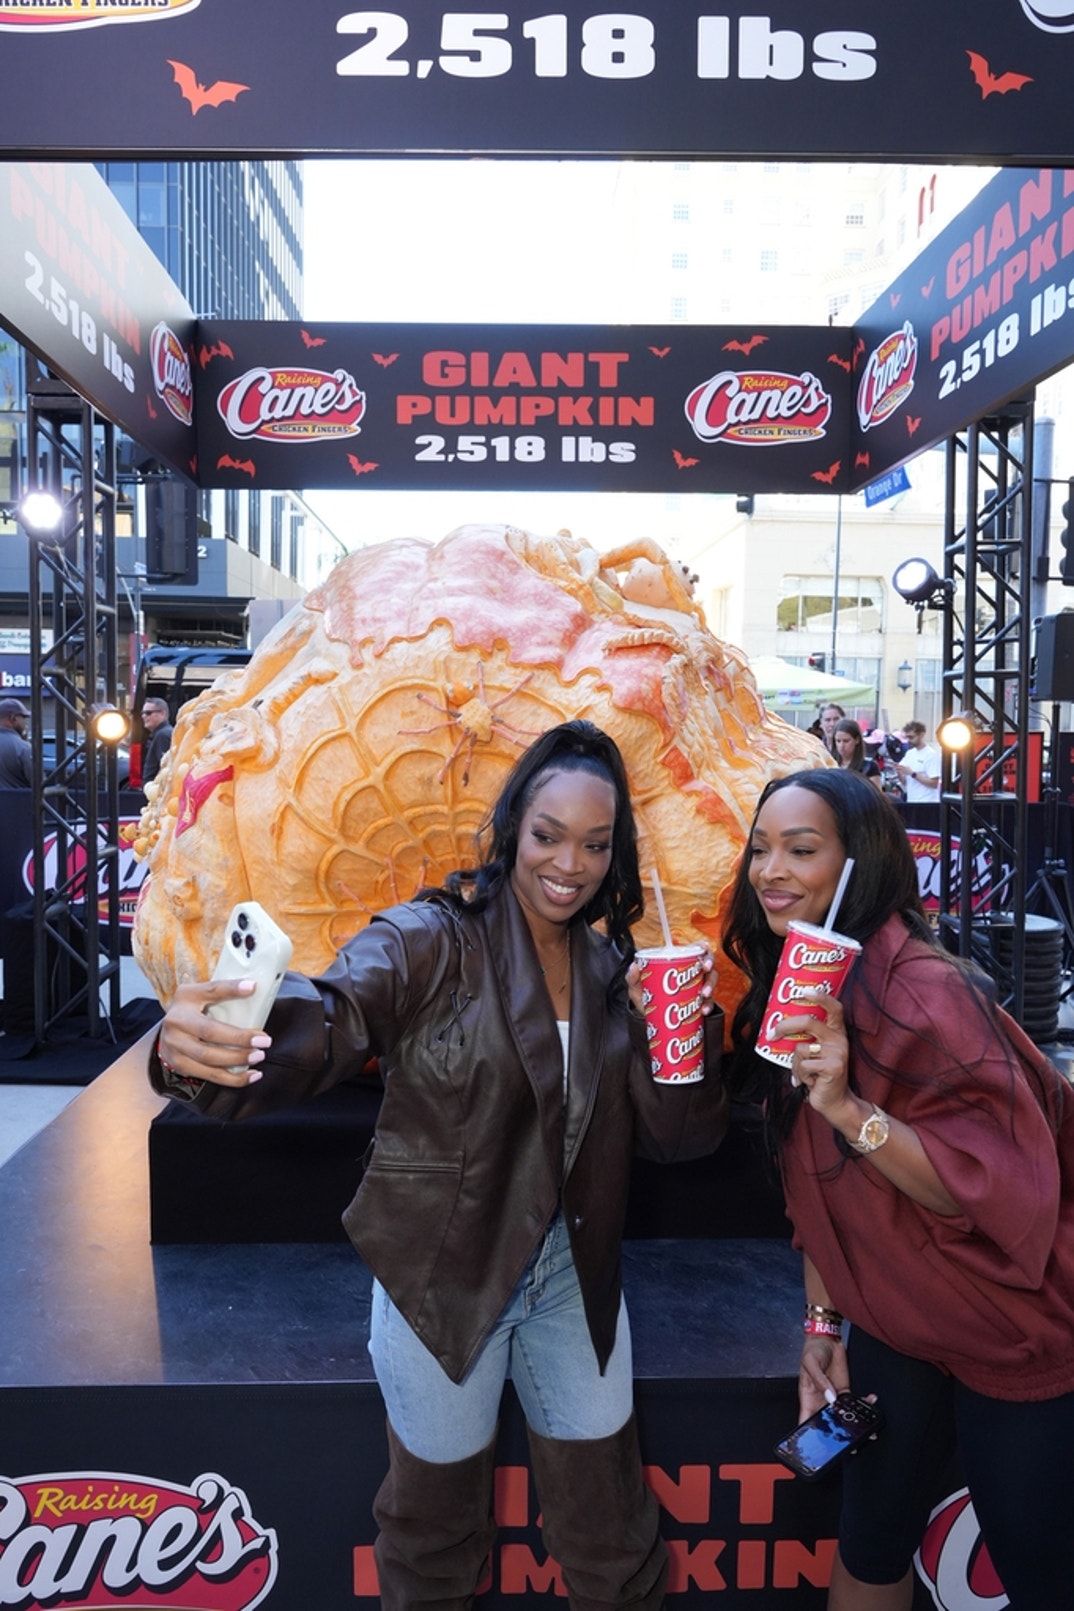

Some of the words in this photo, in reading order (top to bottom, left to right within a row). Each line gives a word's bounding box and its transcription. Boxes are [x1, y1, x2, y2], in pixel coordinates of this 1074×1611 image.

[335, 12, 656, 80] 2,518
[697, 15, 877, 81] lbs
[24, 250, 97, 356] 2,518
[103, 332, 135, 394] lbs
[938, 312, 1020, 400] 2,518
[1030, 277, 1074, 337] lb
[275, 372, 322, 386] Raising
[422, 350, 629, 388] GIANT
[741, 376, 788, 391] Raising
[226, 369, 362, 434] Cane's
[396, 394, 654, 426] PUMPKIN
[694, 373, 828, 437] Cane's
[271, 424, 309, 433] CHICKEN
[310, 424, 348, 434] FINGERS
[738, 427, 774, 436] CHICKEN
[776, 427, 814, 436] FINGERS
[414, 434, 546, 462] 2,518
[561, 436, 636, 463] lbs
[197, 545, 207, 558] 2
[788, 942, 847, 970] Cane's
[34, 1485, 159, 1518] Raising
